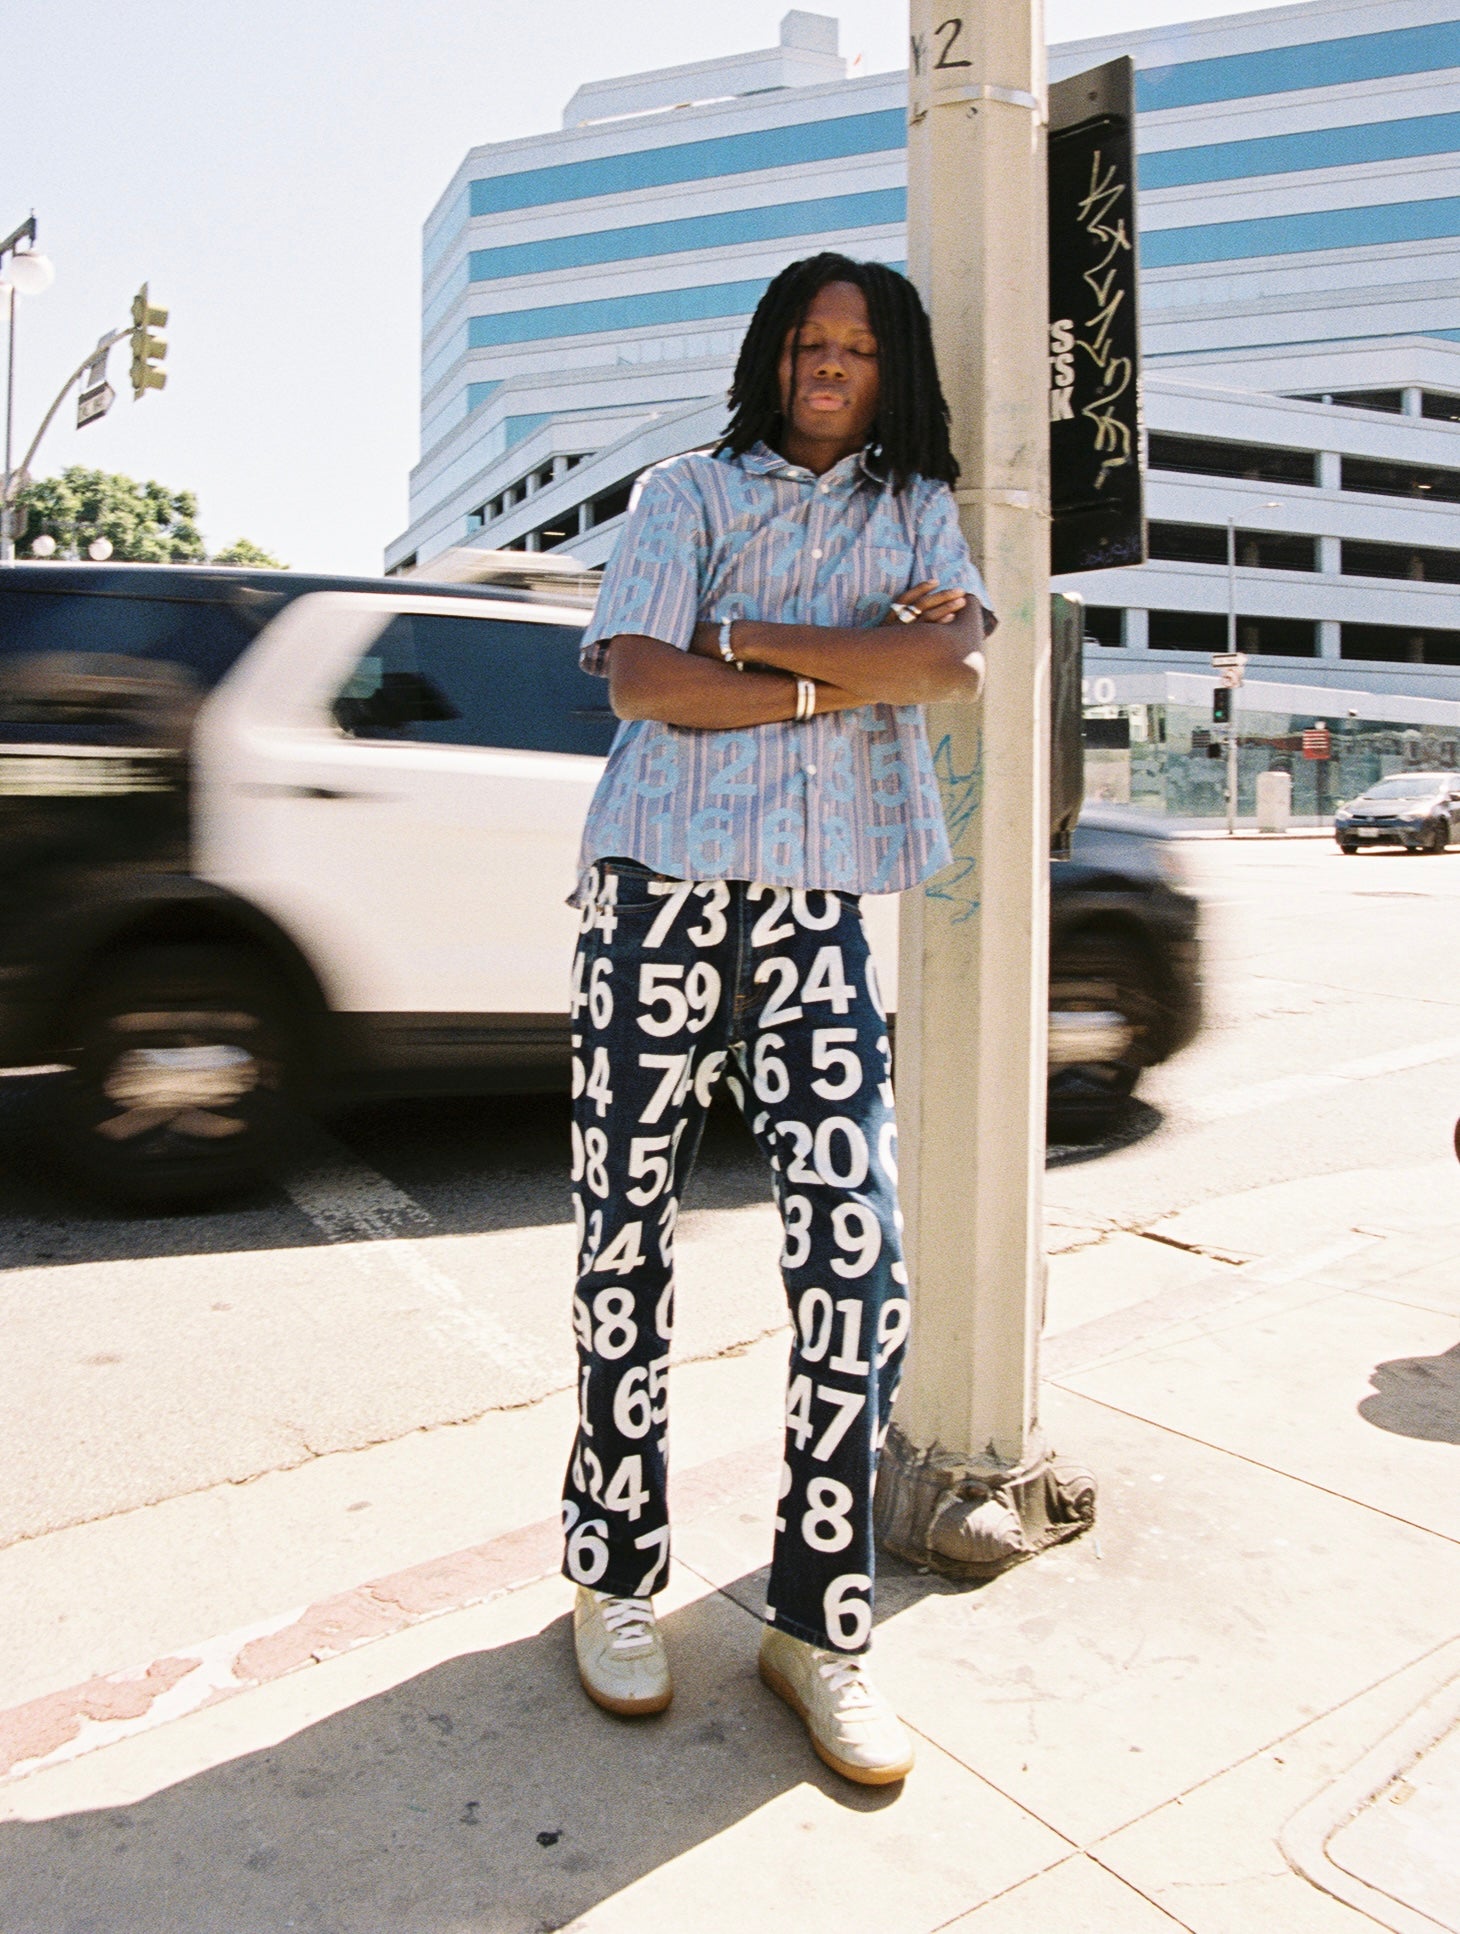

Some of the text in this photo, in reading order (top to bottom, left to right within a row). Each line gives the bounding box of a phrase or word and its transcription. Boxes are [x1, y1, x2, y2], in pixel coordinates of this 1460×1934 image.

[934, 18, 972, 69] 2
[636, 961, 722, 1038] 59
[754, 946, 857, 1029] 24
